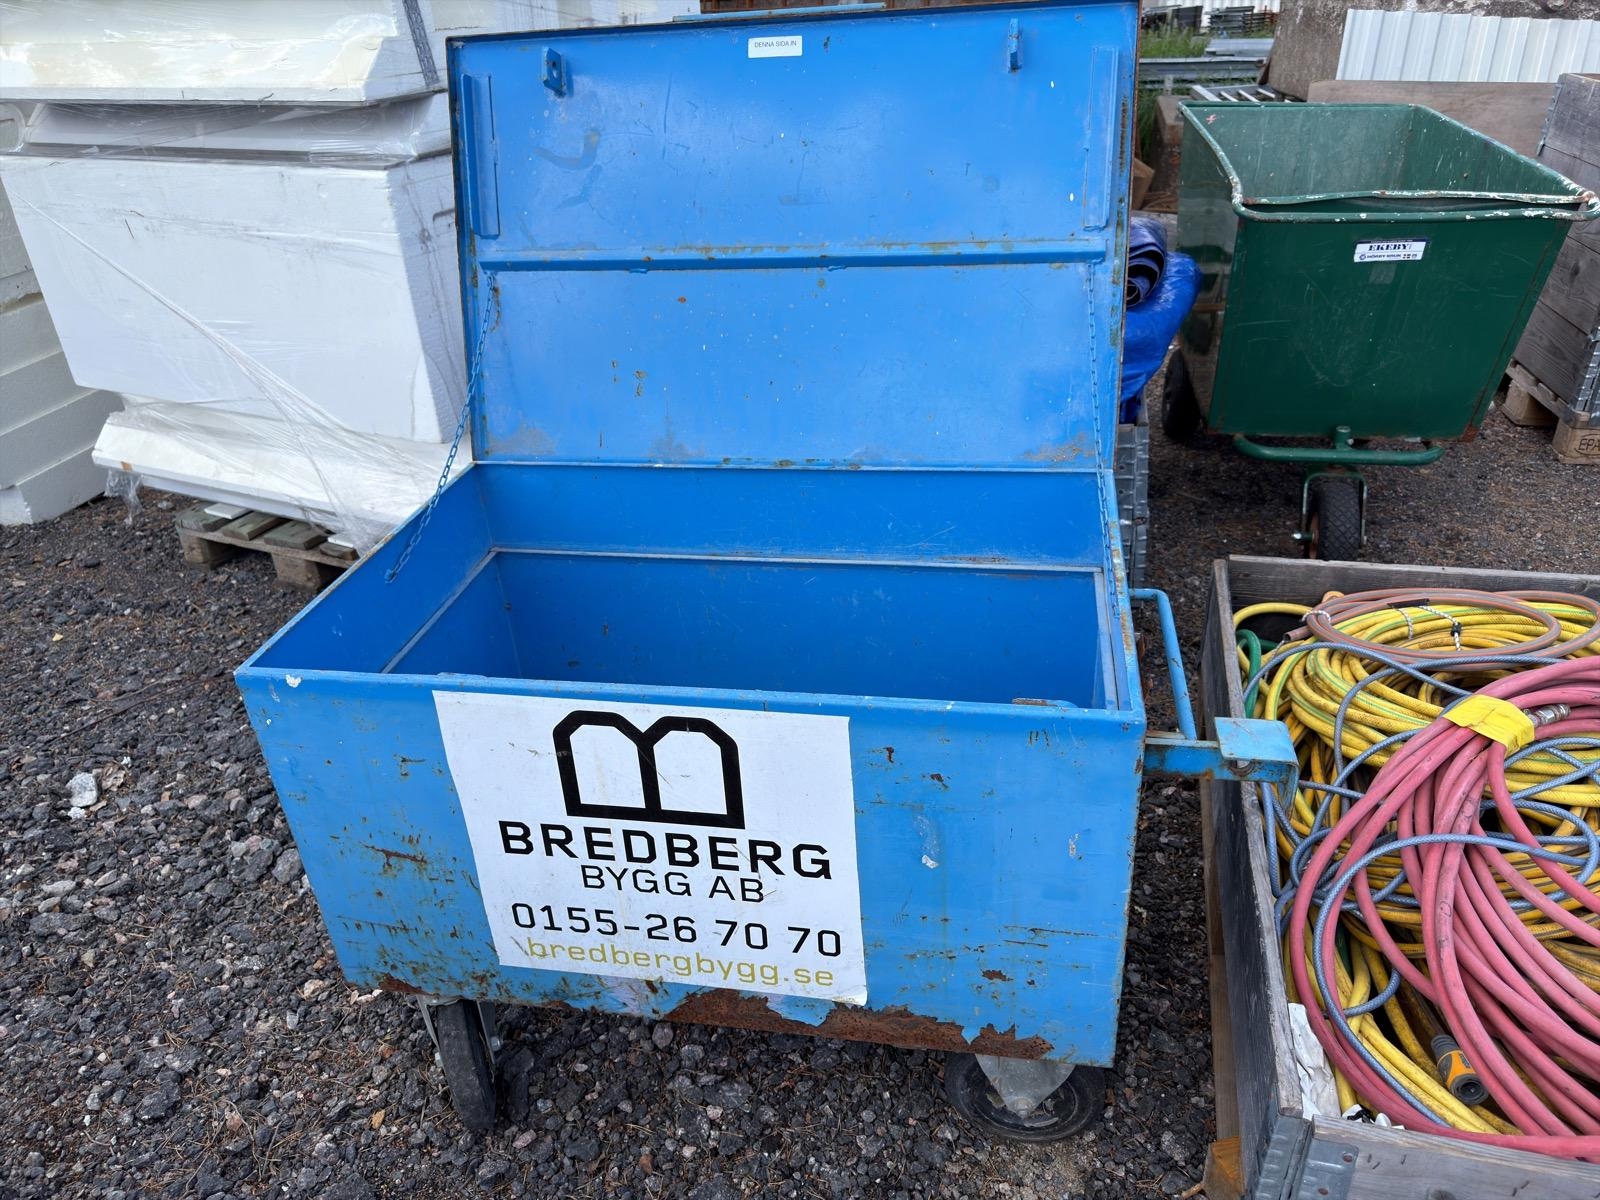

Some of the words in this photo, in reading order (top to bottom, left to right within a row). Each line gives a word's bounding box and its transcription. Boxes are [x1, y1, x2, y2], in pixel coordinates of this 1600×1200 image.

[498, 820, 833, 880] BREDBERG
[580, 864, 693, 897] BYGG
[708, 875, 765, 903] AB
[511, 902, 698, 943] 0155-26
[715, 919, 769, 950] 70
[787, 926, 842, 958] 70
[527, 937, 834, 987] bredbergbygg.se
